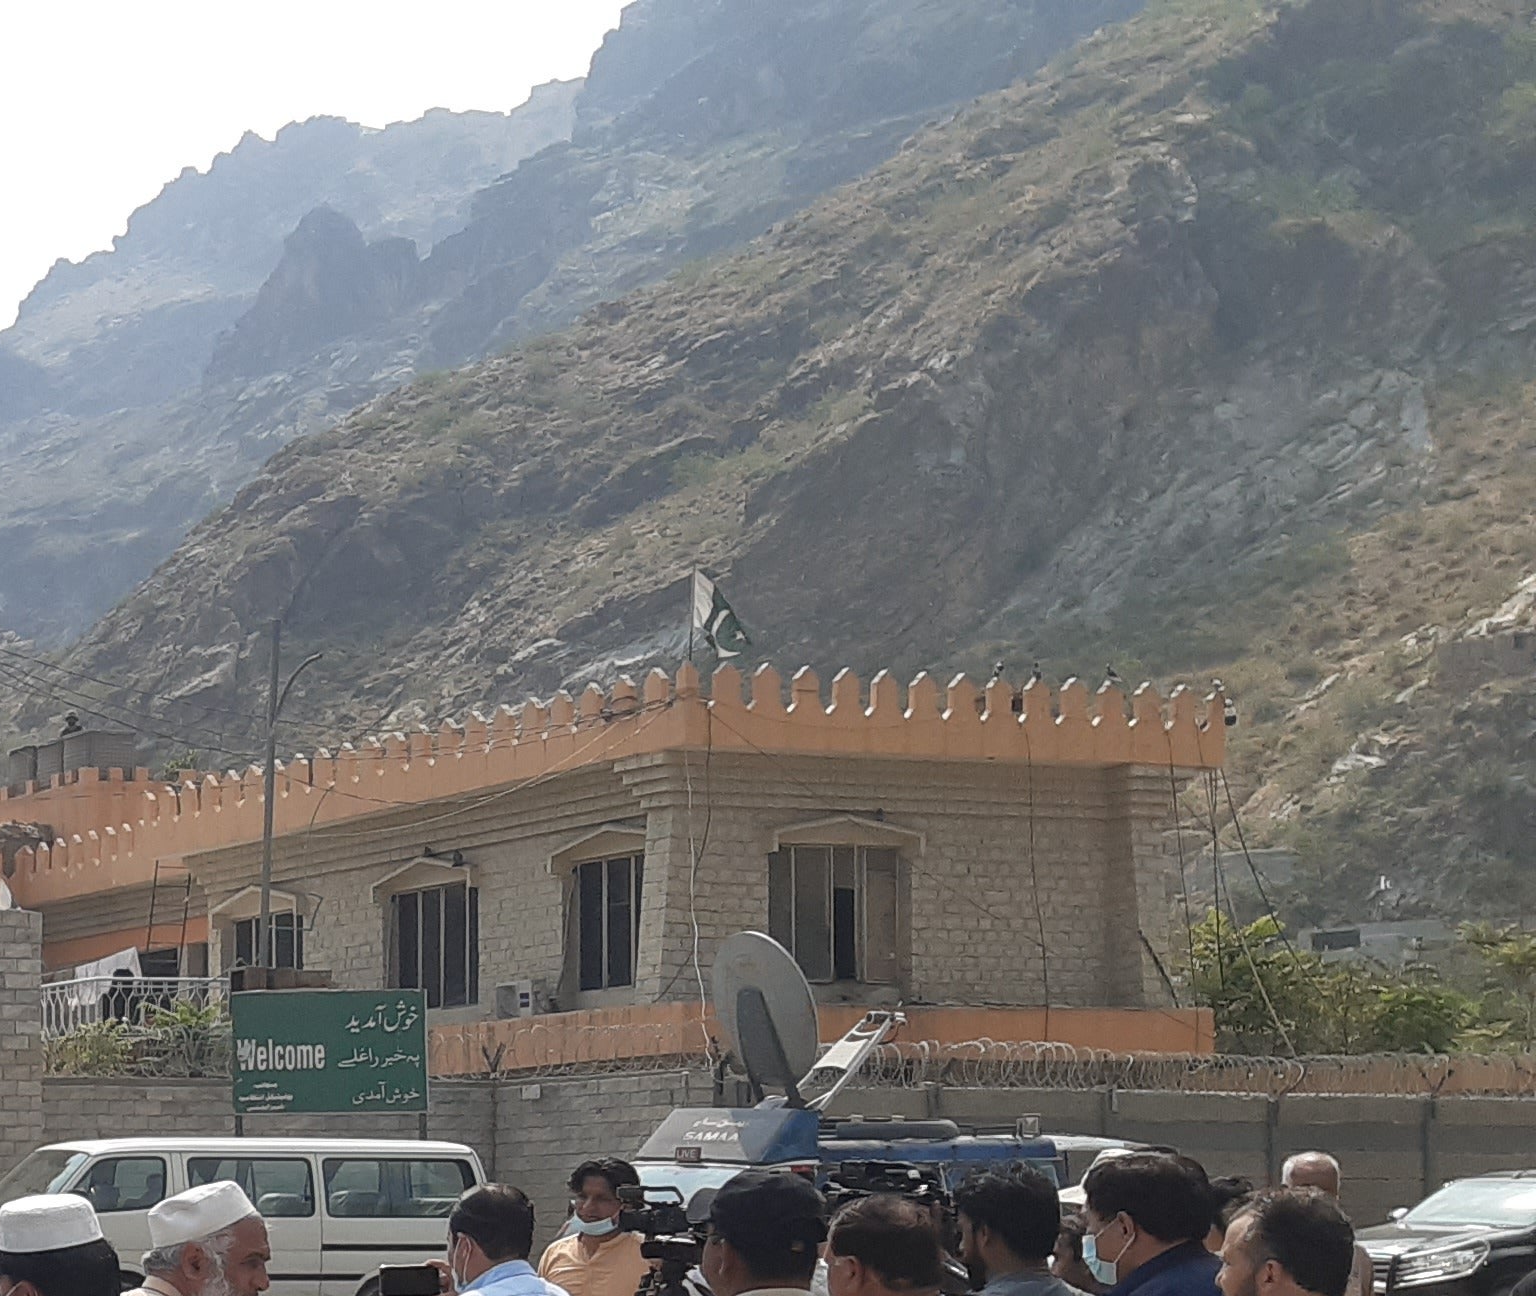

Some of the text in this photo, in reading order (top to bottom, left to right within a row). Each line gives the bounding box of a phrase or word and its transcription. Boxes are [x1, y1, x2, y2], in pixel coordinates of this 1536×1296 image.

[345, 999, 420, 1035] خوش آمدید
[236, 1038, 327, 1072] Welcome
[385, 1086, 421, 1106] خوش
[683, 1131, 740, 1142] SAMAA
[676, 1148, 697, 1158] LIVE
